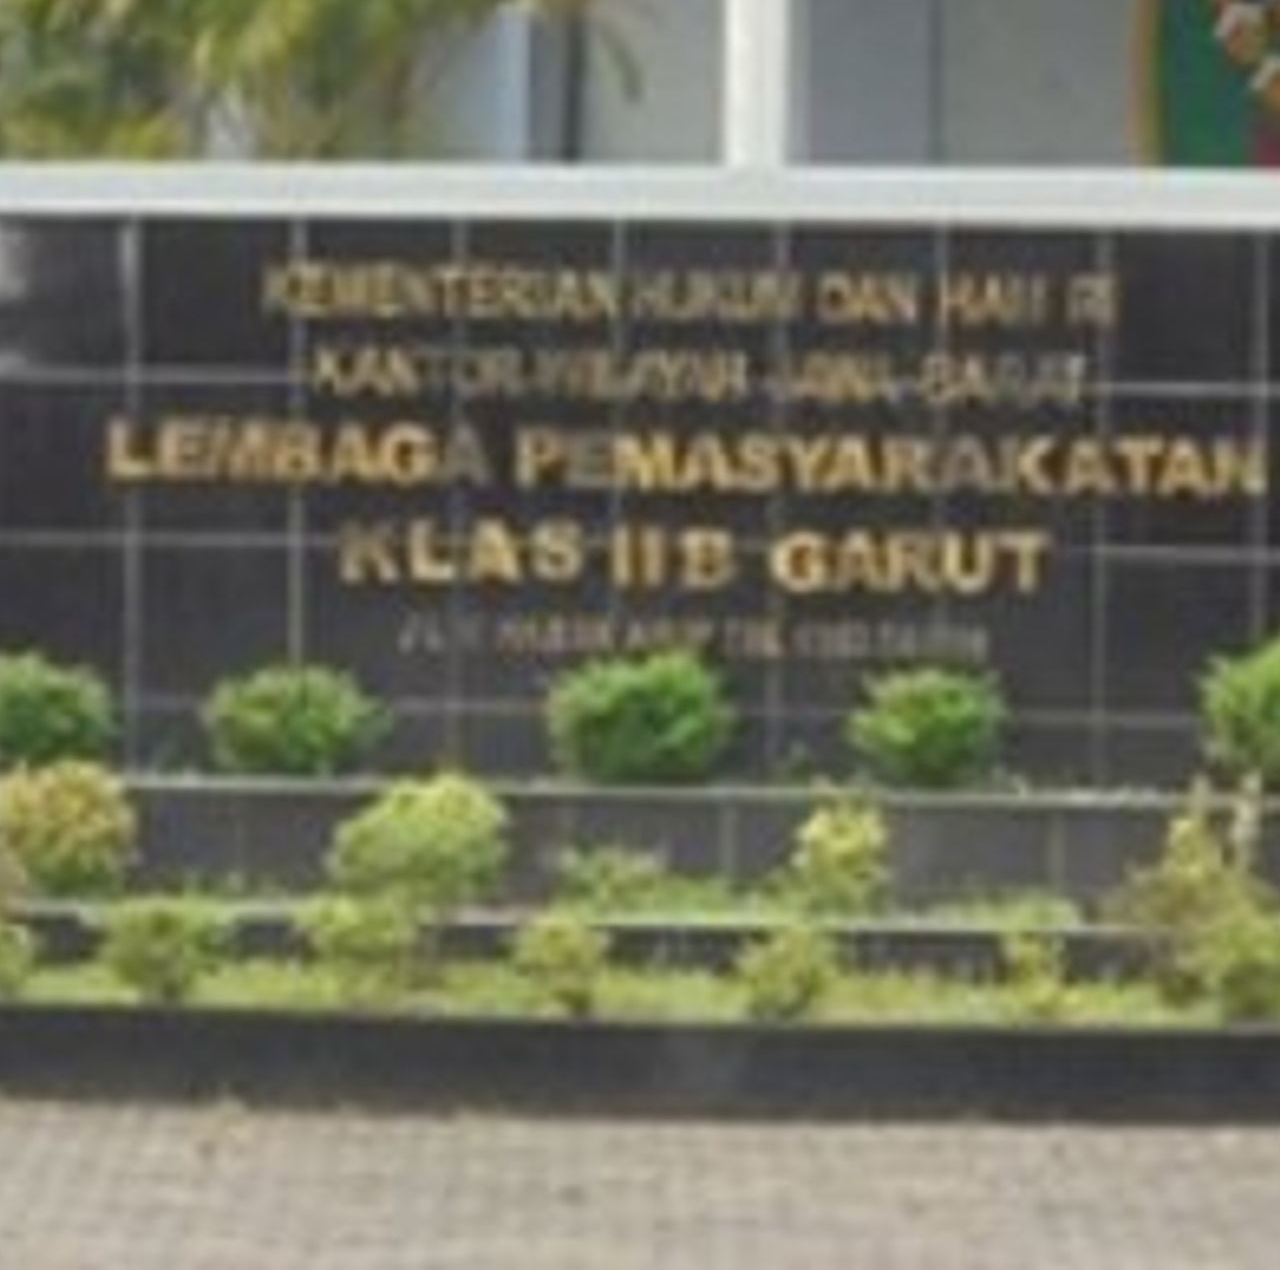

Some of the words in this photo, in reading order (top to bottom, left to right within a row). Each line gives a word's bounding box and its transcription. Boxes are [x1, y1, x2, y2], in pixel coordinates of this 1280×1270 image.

[818, 268, 920, 322] DAN
[106, 416, 490, 485] LEMBAGA
[514, 430, 1270, 495] PEMASYARAKATAN
[338, 518, 584, 582] KLAS
[770, 530, 1050, 592] GARUT
